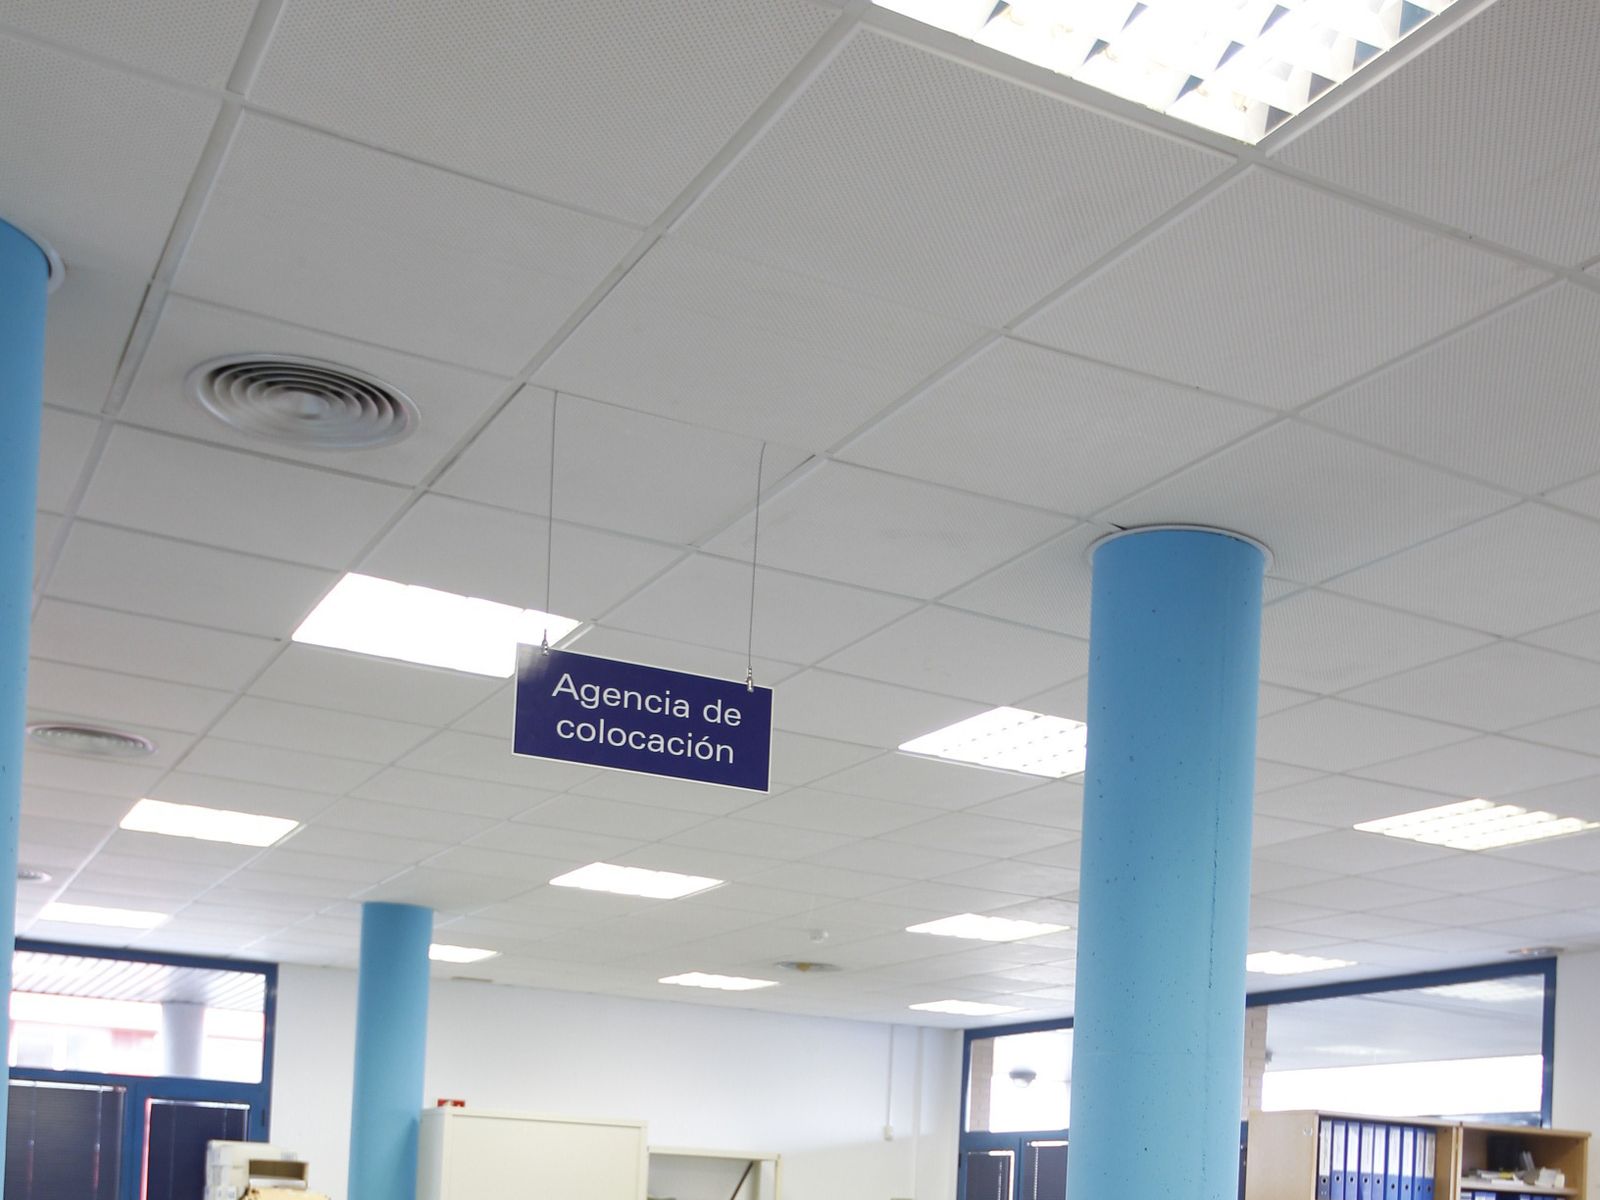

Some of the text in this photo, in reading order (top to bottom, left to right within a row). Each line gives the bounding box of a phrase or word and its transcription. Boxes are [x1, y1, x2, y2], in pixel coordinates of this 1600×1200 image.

[551, 672, 742, 727] Agencia de
[556, 718, 734, 764] colocación
